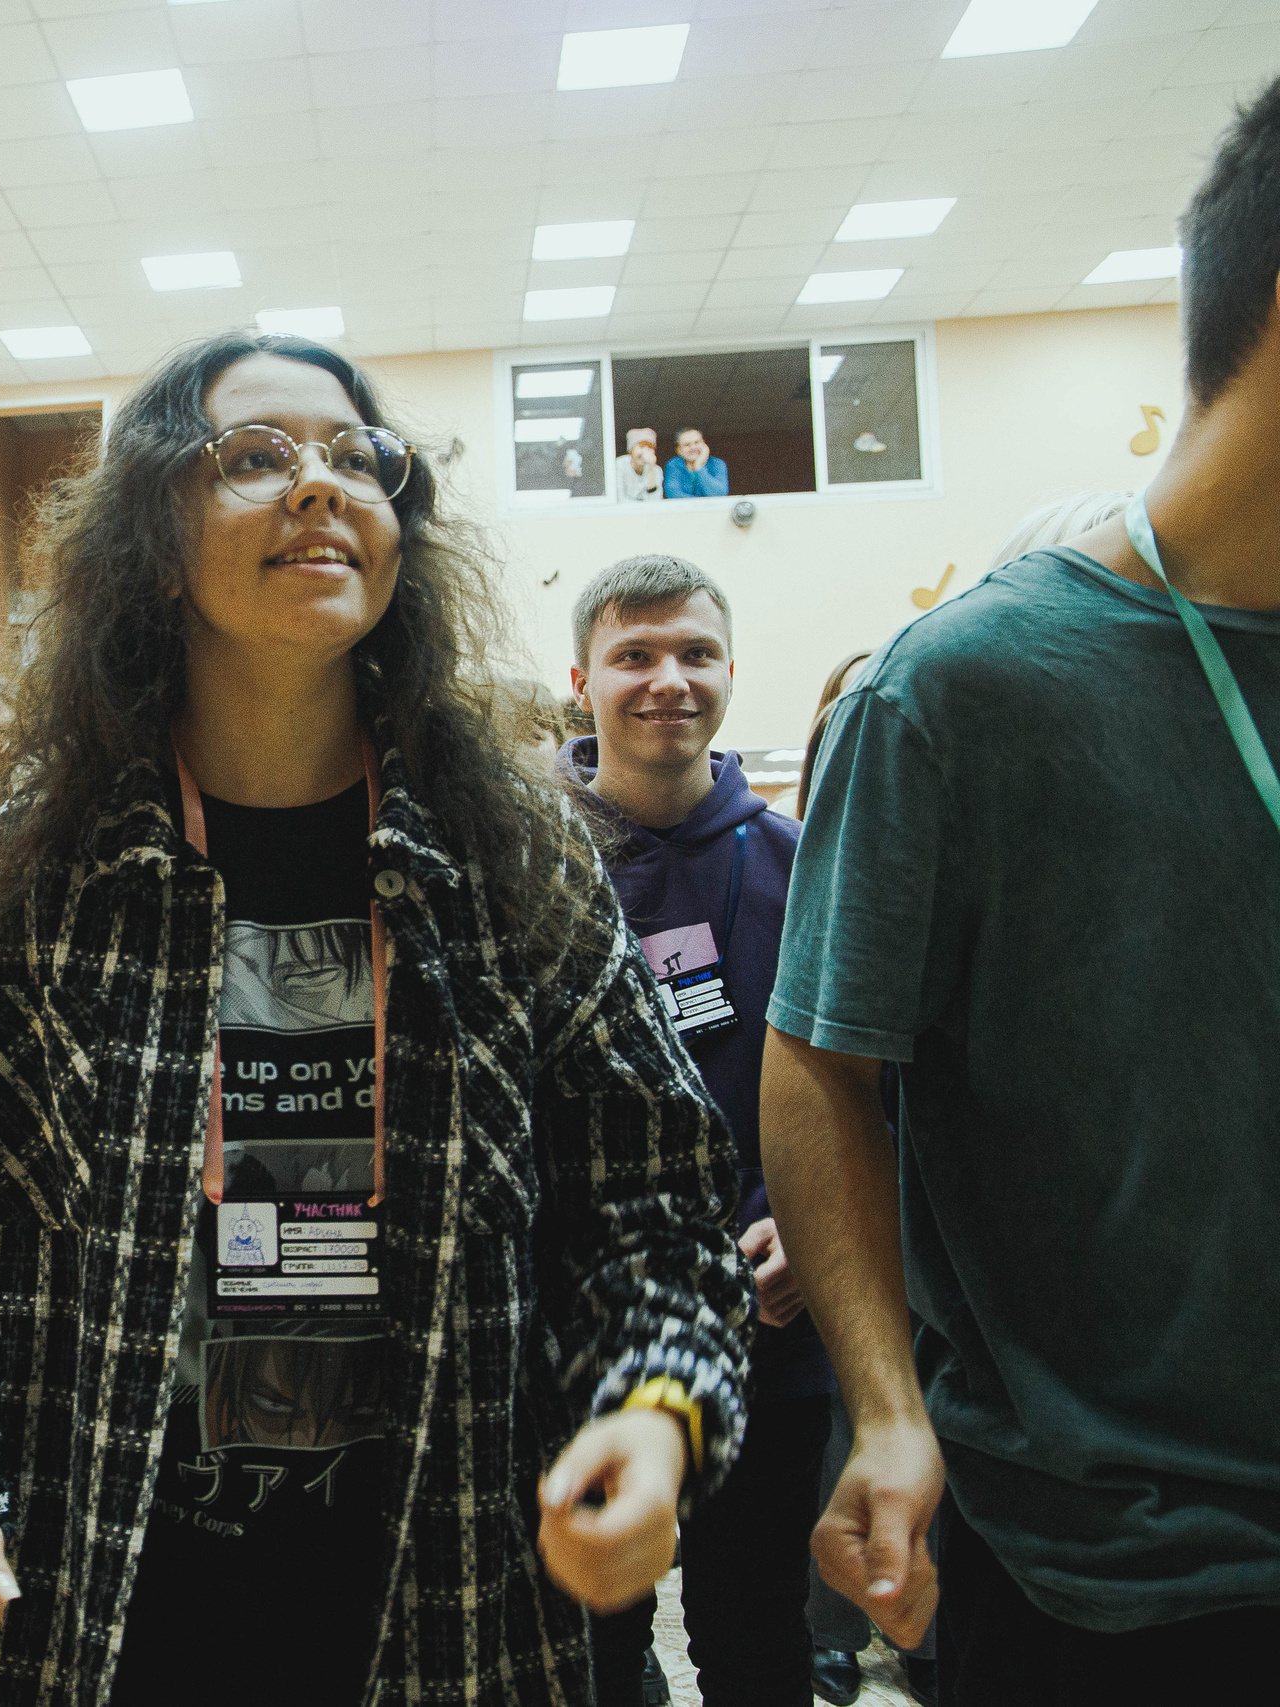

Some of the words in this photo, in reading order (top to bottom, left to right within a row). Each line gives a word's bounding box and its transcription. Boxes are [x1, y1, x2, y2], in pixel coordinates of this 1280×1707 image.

[662, 951, 682, 975] IT
[677, 971, 713, 987] УЧАСТНИК
[237, 1060, 278, 1085] up
[290, 1061, 332, 1082] on
[276, 1088, 343, 1113] and
[294, 1202, 363, 1218] УЧАСТНИК
[192, 1510, 245, 1537] Corps
